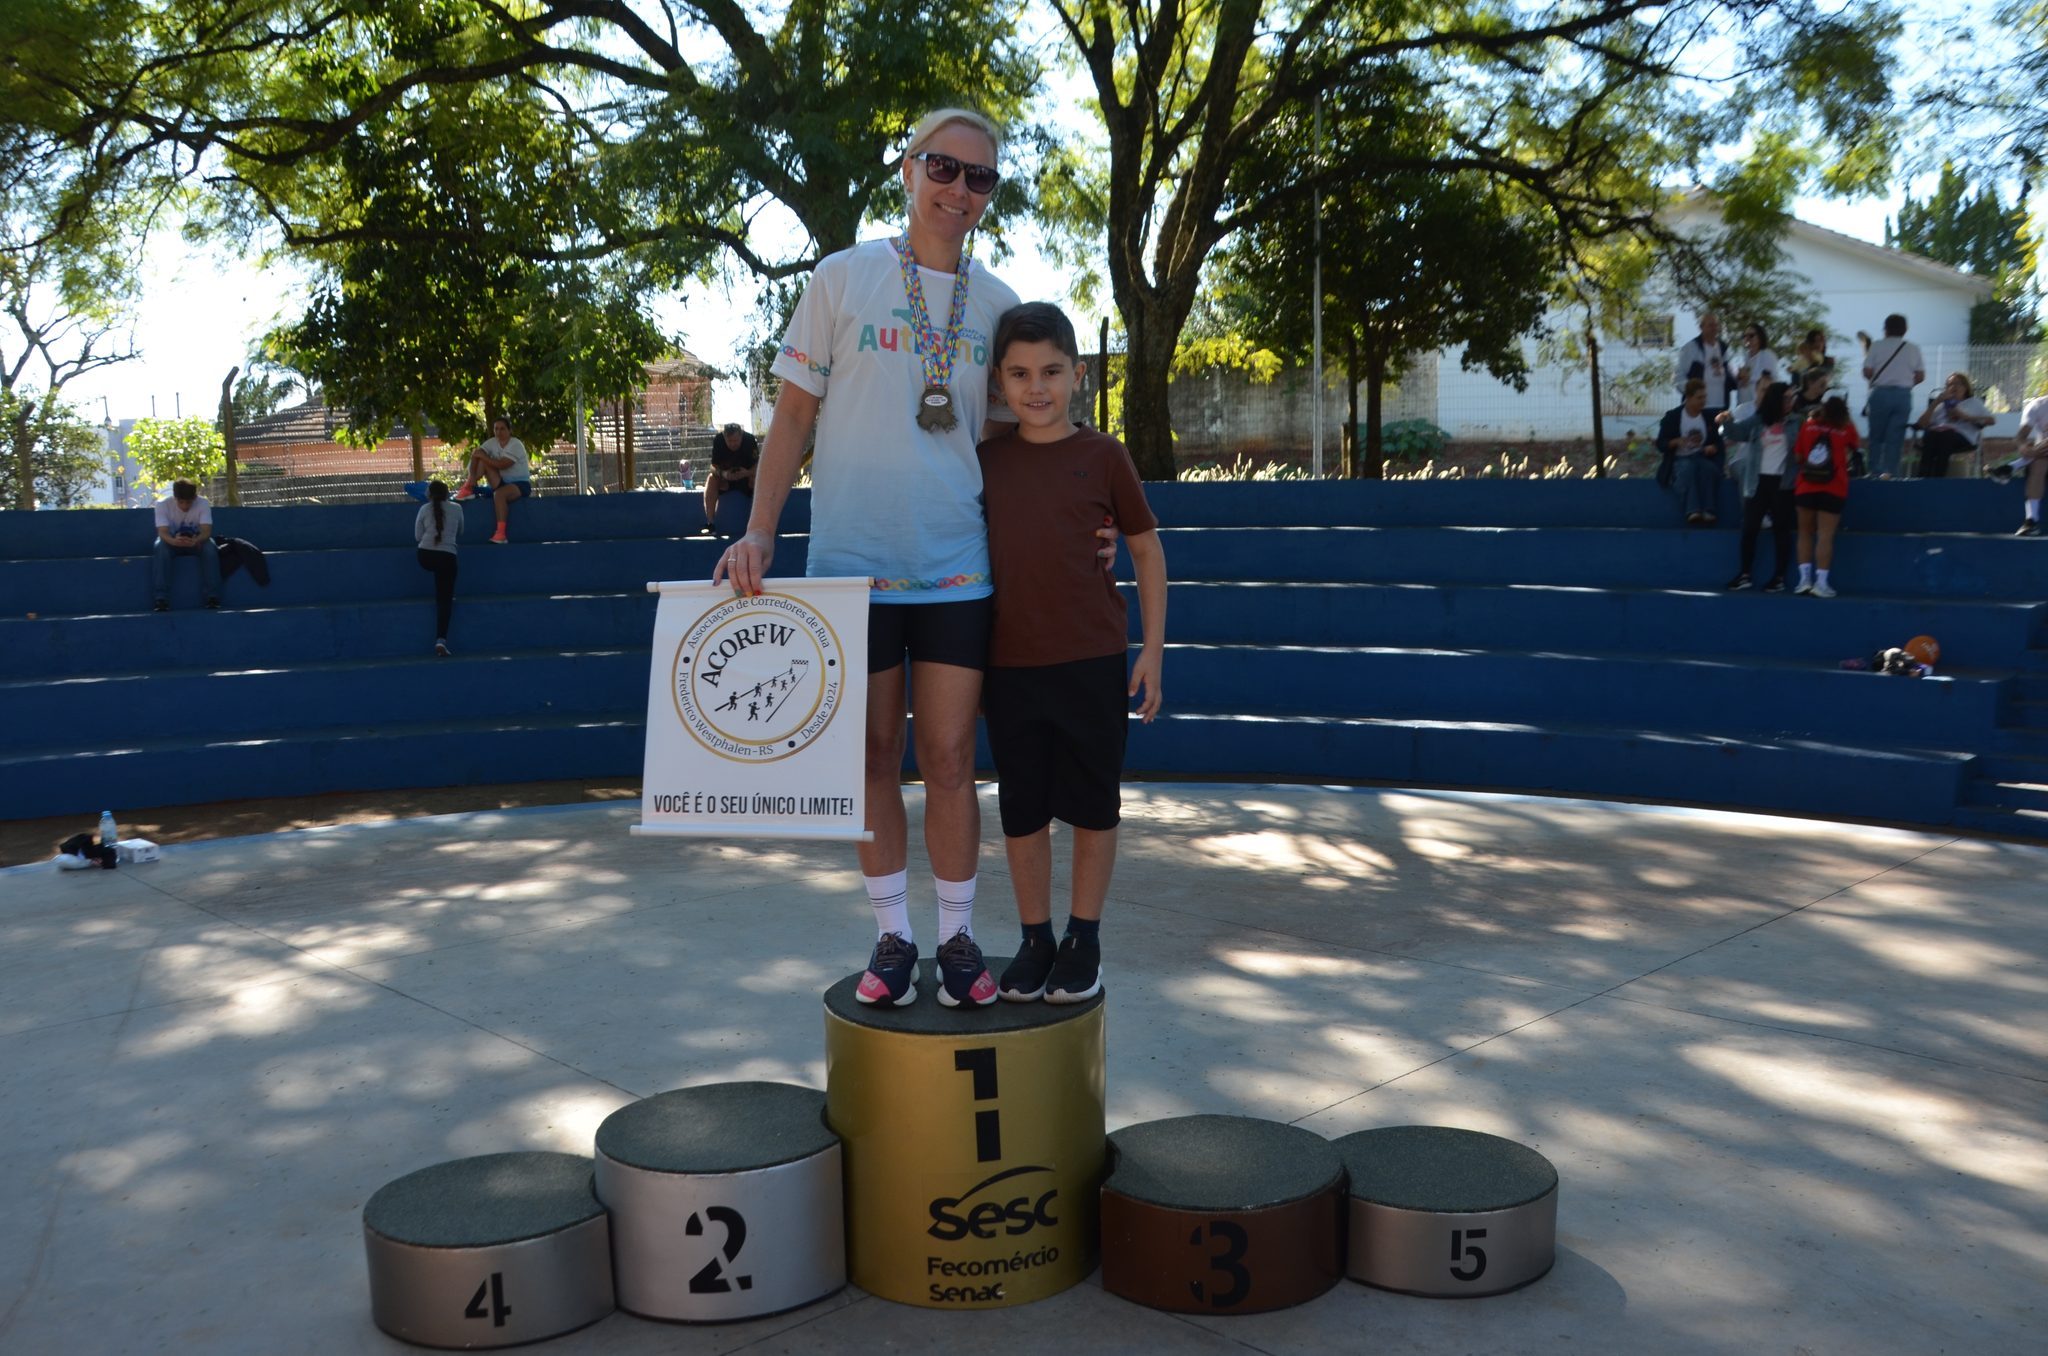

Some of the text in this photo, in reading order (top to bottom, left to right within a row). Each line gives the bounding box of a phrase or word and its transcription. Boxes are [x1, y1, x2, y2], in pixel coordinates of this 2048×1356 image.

[687, 597, 830, 649] Associação de Corredores de Rua
[700, 622, 796, 688] ACORFW
[679, 672, 697, 722] Frederico
[801, 682, 838, 740] Desde 2024
[653, 791, 853, 816] VOCÊ É O SEU ÚNICO LIMITE!
[954, 1047, 1001, 1162] 1
[927, 1166, 1058, 1241] Sesc
[685, 1206, 753, 1294] 2
[927, 1245, 1059, 1277] Fecomércio
[1190, 1220, 1249, 1308] 3
[1450, 1228, 1487, 1282] 5
[464, 1272, 512, 1328] 4
[929, 1283, 1004, 1302] Senac
